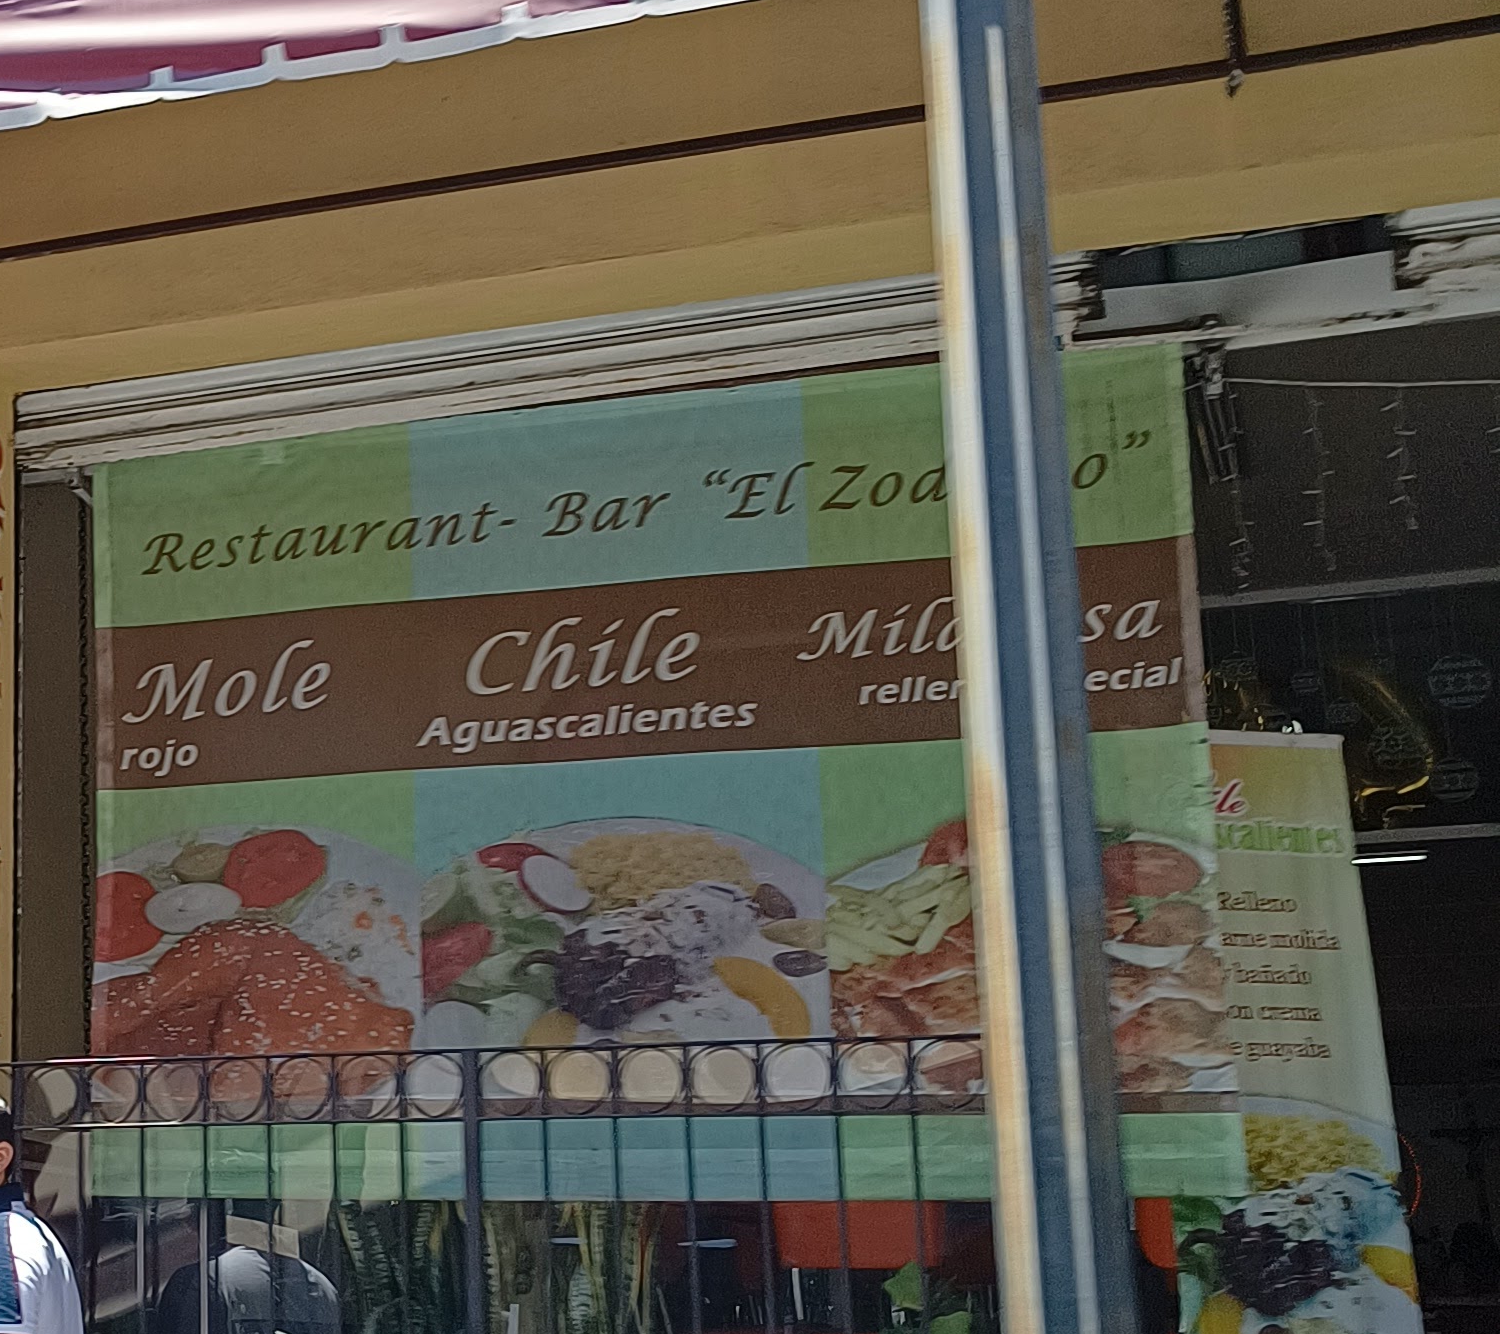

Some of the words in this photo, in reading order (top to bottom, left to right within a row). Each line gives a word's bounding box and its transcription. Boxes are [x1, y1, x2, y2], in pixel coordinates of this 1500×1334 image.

[143, 502, 517, 575] Restaurant-
[543, 490, 668, 538] Bar
[819, 430, 1152, 513] Zodo”
[118, 740, 199, 776] rojo
[416, 697, 758, 754] Aguascalientes
[857, 674, 964, 706] relle
[1084, 657, 1184, 692] ecial
[121, 640, 333, 724] Mole
[466, 607, 701, 697] Chile
[796, 596, 1164, 664] Milasa
